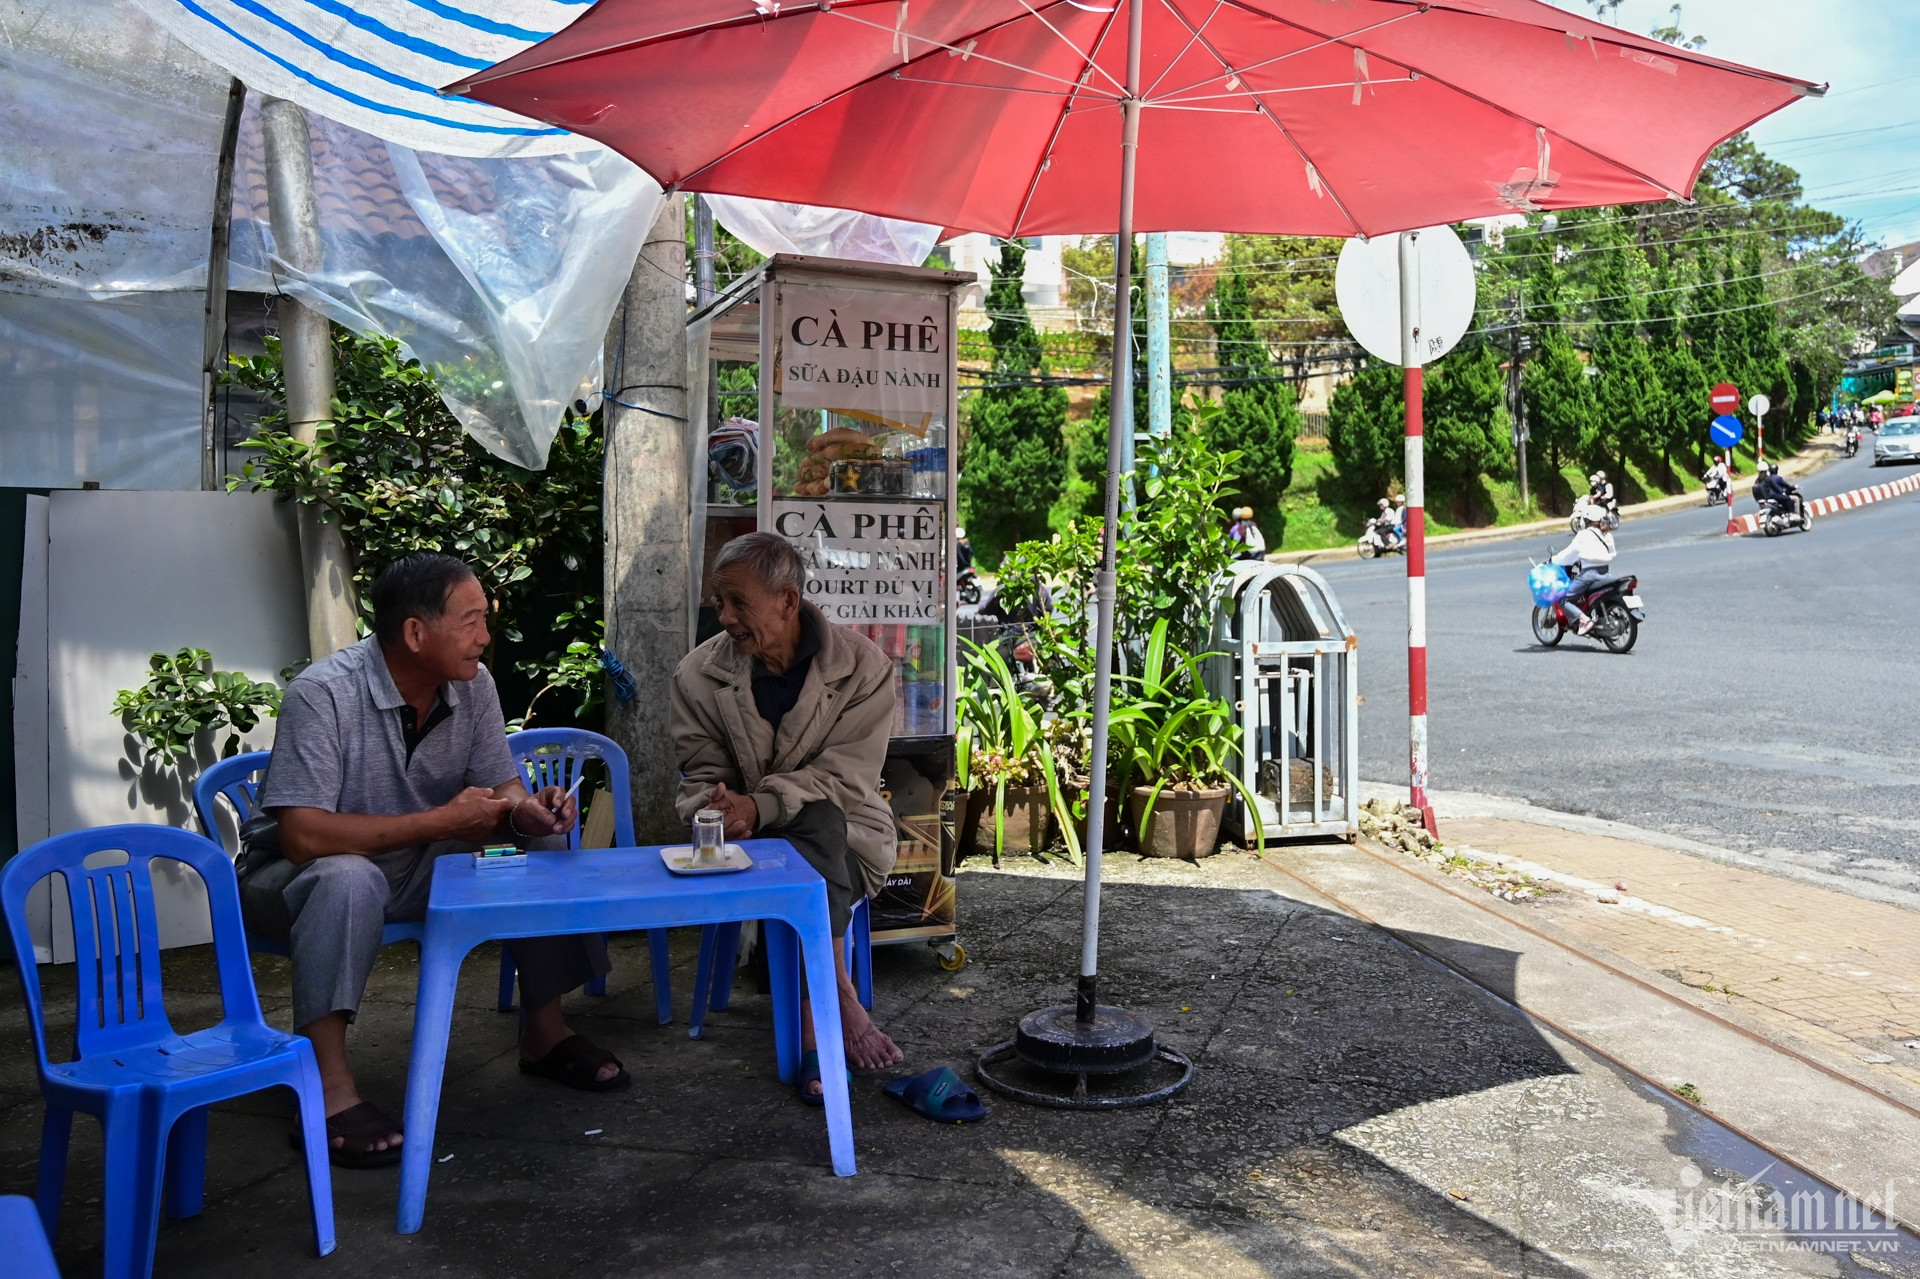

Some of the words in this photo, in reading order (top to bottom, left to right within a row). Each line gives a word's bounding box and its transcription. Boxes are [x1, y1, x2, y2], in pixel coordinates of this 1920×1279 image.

[791, 309, 849, 348] CÀ
[861, 315, 940, 354] PHÊ
[789, 362, 830, 383] SỮA
[836, 367, 879, 388] ĐẬU
[884, 368, 942, 388] NÀNH
[775, 504, 839, 539] CÀ
[851, 507, 936, 541] PHÊ
[876, 546, 936, 570] NÀNH
[803, 579, 869, 595] OURT
[875, 576, 904, 595] ĐỦ
[911, 580, 934, 598] VỊ
[836, 600, 878, 618] GIẢI
[883, 599, 937, 619] KHÁC
